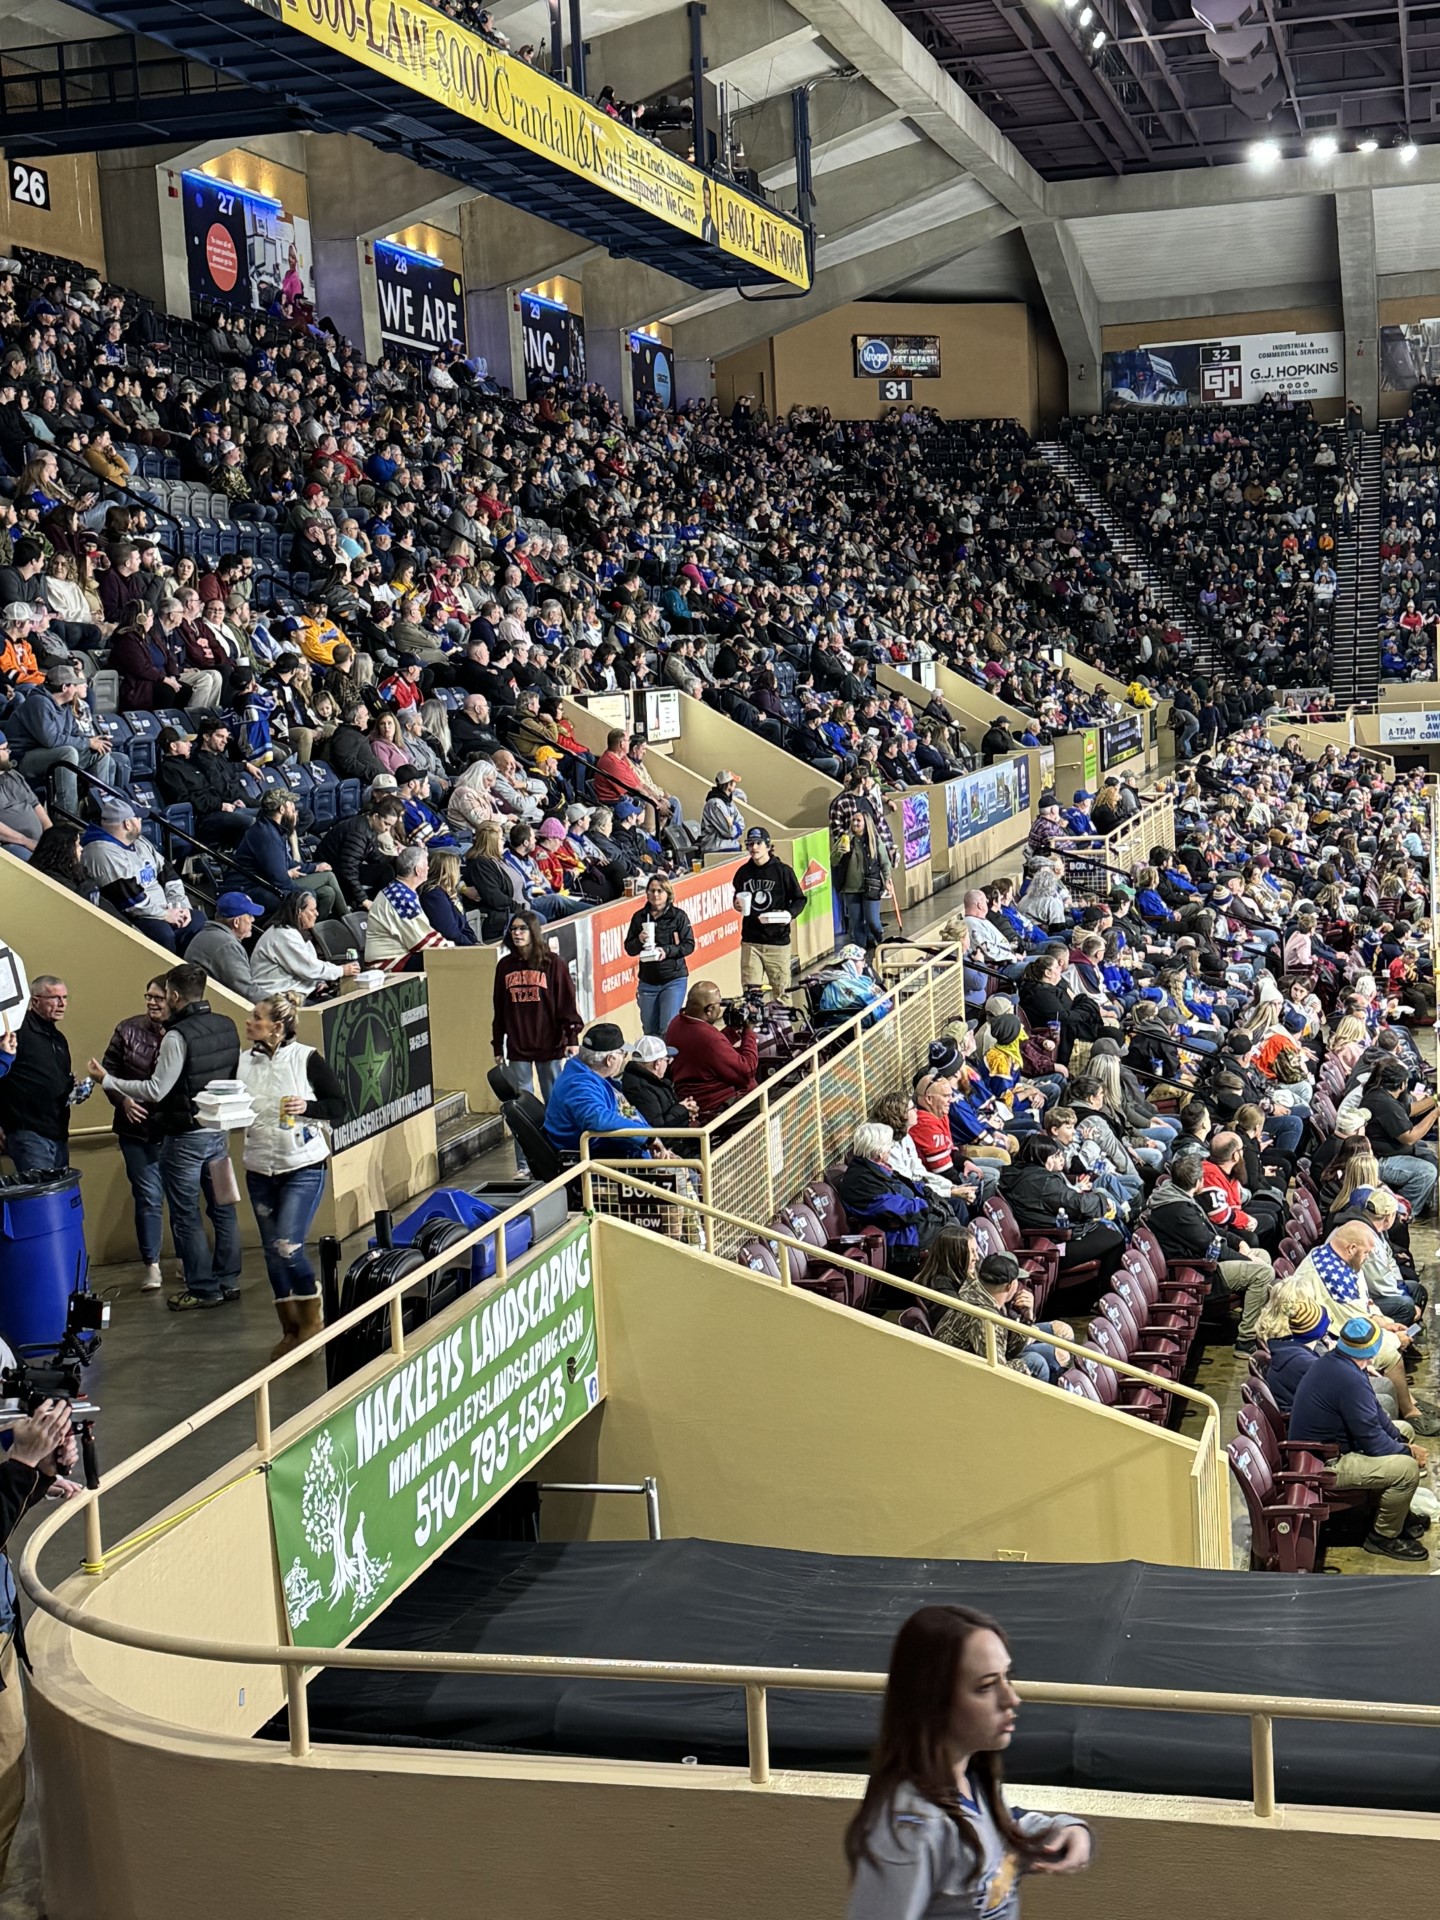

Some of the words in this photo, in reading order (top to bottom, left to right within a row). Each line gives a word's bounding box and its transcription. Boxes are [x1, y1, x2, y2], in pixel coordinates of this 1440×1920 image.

[646, 151, 665, 178] Truck
[13, 166, 46, 206] 26
[217, 191, 236, 216] 27
[663, 188, 678, 216] We
[394, 253, 408, 275] 28
[378, 279, 415, 334] WE
[421, 294, 458, 342] ARE
[529, 302, 541, 320] 29
[1212, 349, 1230, 361] 32
[1258, 350, 1299, 359] COMMERCIAL
[1300, 347, 1329, 356] SERVICES
[1272, 341, 1308, 351] INDUSTRIAL
[863, 346, 888, 369] Kroger
[892, 355, 908, 363] GET
[908, 355, 915, 363] IT
[1250, 367, 1275, 380] G.J.
[1276, 362, 1339, 378] HOPKINS
[885, 381, 907, 400] 31
[1069, 861, 1087, 871] BOX
[701, 885, 722, 921] EACH
[600, 925, 622, 966] RUN
[601, 972, 621, 994] GREAT
[333, 1084, 432, 1149] BIGLICKSCREENPRINTING.COM
[1210, 1192, 1228, 1208] 19
[635, 1218, 661, 1228] ROW
[355, 1326, 465, 1470] NACKLEYS
[470, 1233, 591, 1378] LANDSCAPING
[389, 1306, 584, 1499] WWW.NACKLEYSLANDSCAPING.COM
[414, 1365, 566, 1547] 540-793-1523
